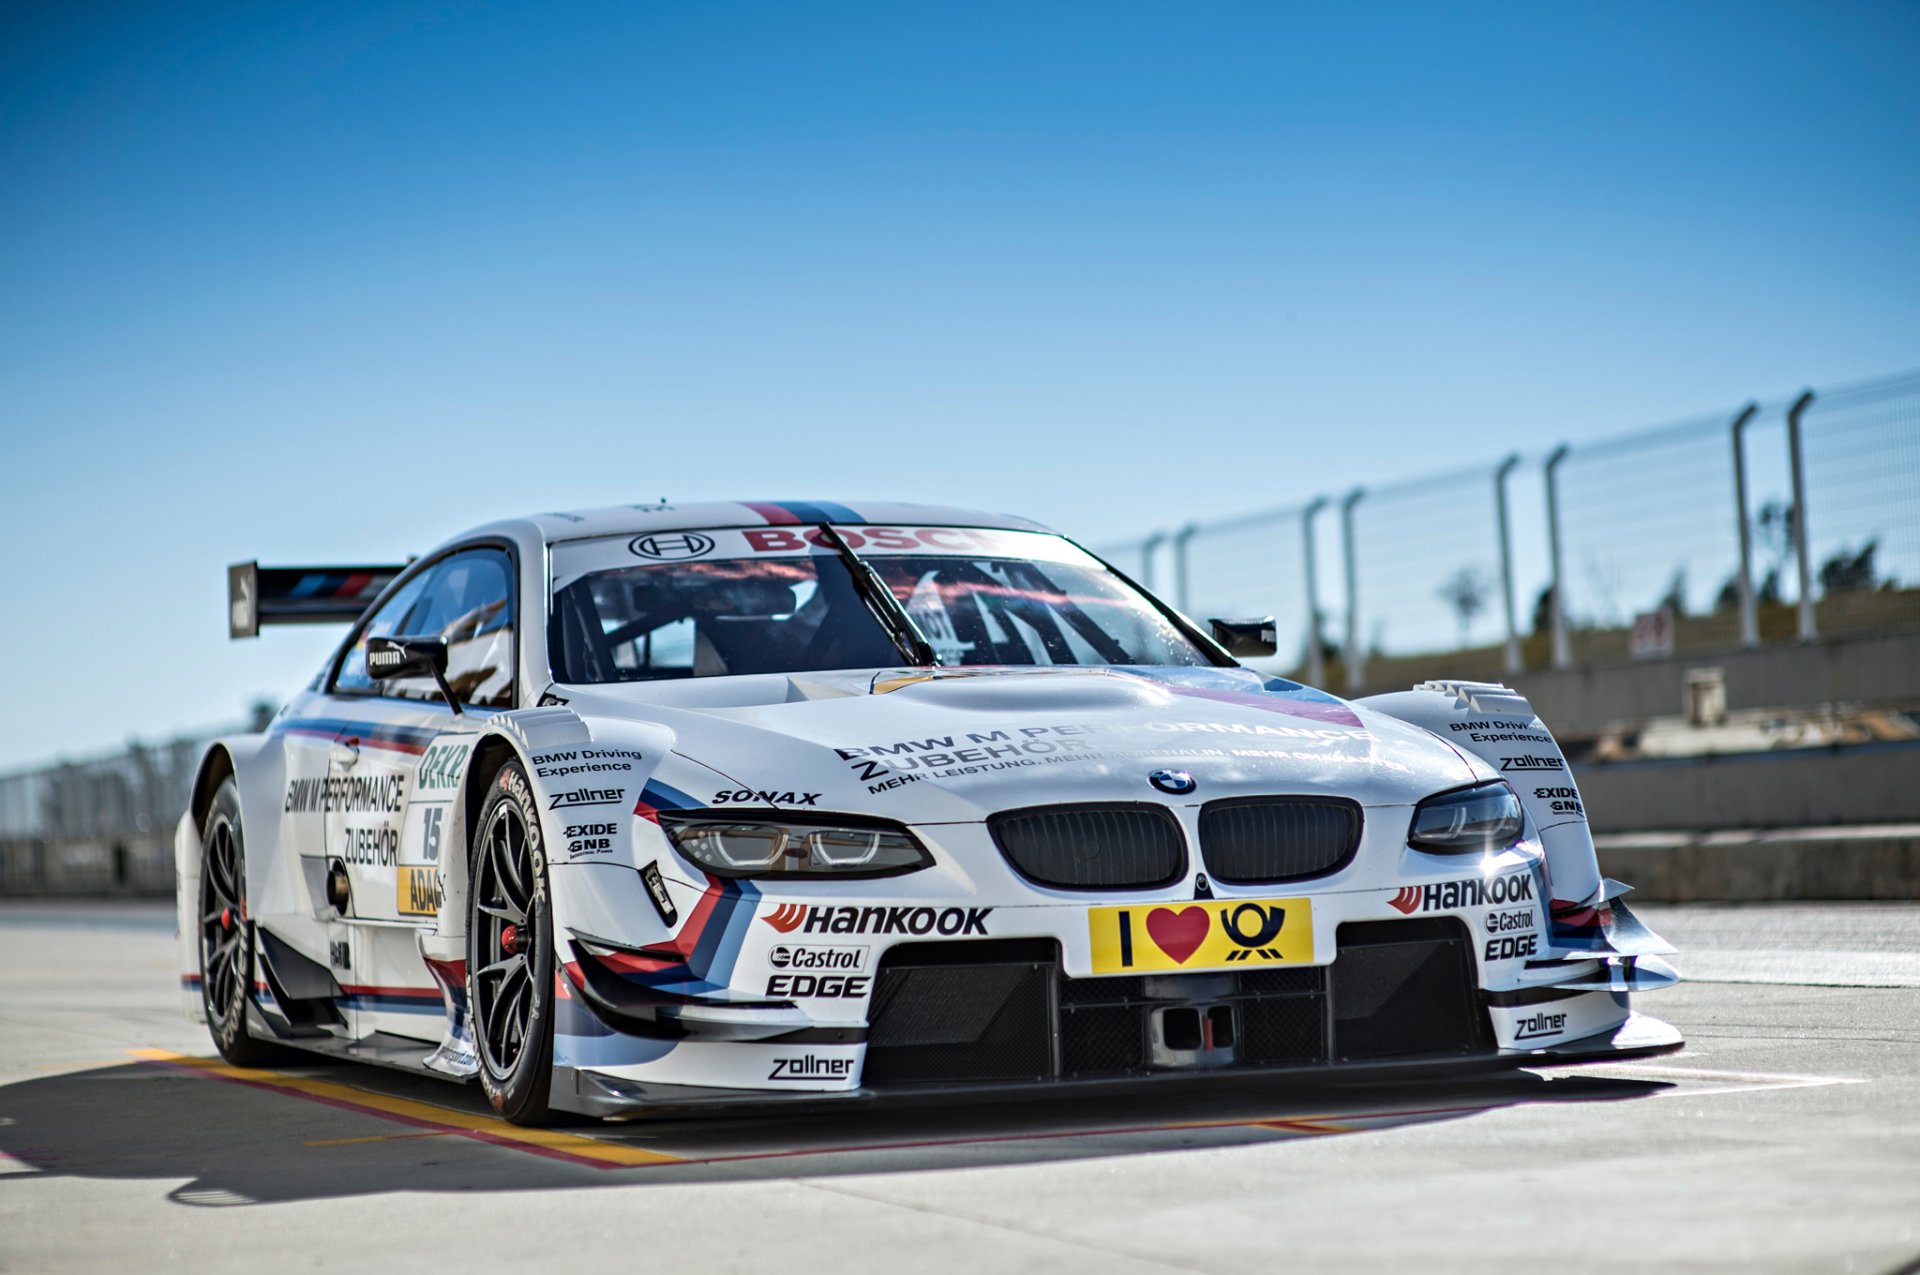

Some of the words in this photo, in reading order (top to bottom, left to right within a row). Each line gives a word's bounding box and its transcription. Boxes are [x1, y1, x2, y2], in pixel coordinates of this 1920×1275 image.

[369, 651, 401, 667] PUMA
[1449, 721, 1491, 732] BMW
[834, 736, 955, 761] BMW
[966, 731, 1012, 743] M
[1470, 732, 1553, 744] Experience
[532, 750, 577, 765] BMW
[582, 749, 642, 761] Driving
[851, 739, 1097, 781] ZUBEHÖR
[537, 762, 632, 777] Experience
[318, 774, 405, 813] PERFORMANCE
[868, 772, 929, 795] MEHR
[1534, 787, 1579, 800] EXIDE
[712, 790, 823, 806] SONAX
[423, 808, 443, 860] 15
[563, 823, 618, 838] EXIDE
[345, 820, 399, 867] ZUBEHÖR
[568, 839, 611, 852] GNB
[1500, 909, 1534, 931] Castrol
[1118, 911, 1133, 967] I
[1485, 934, 1538, 961] EDGE
[792, 948, 862, 968] Castrol
[765, 974, 872, 998] EDGE
